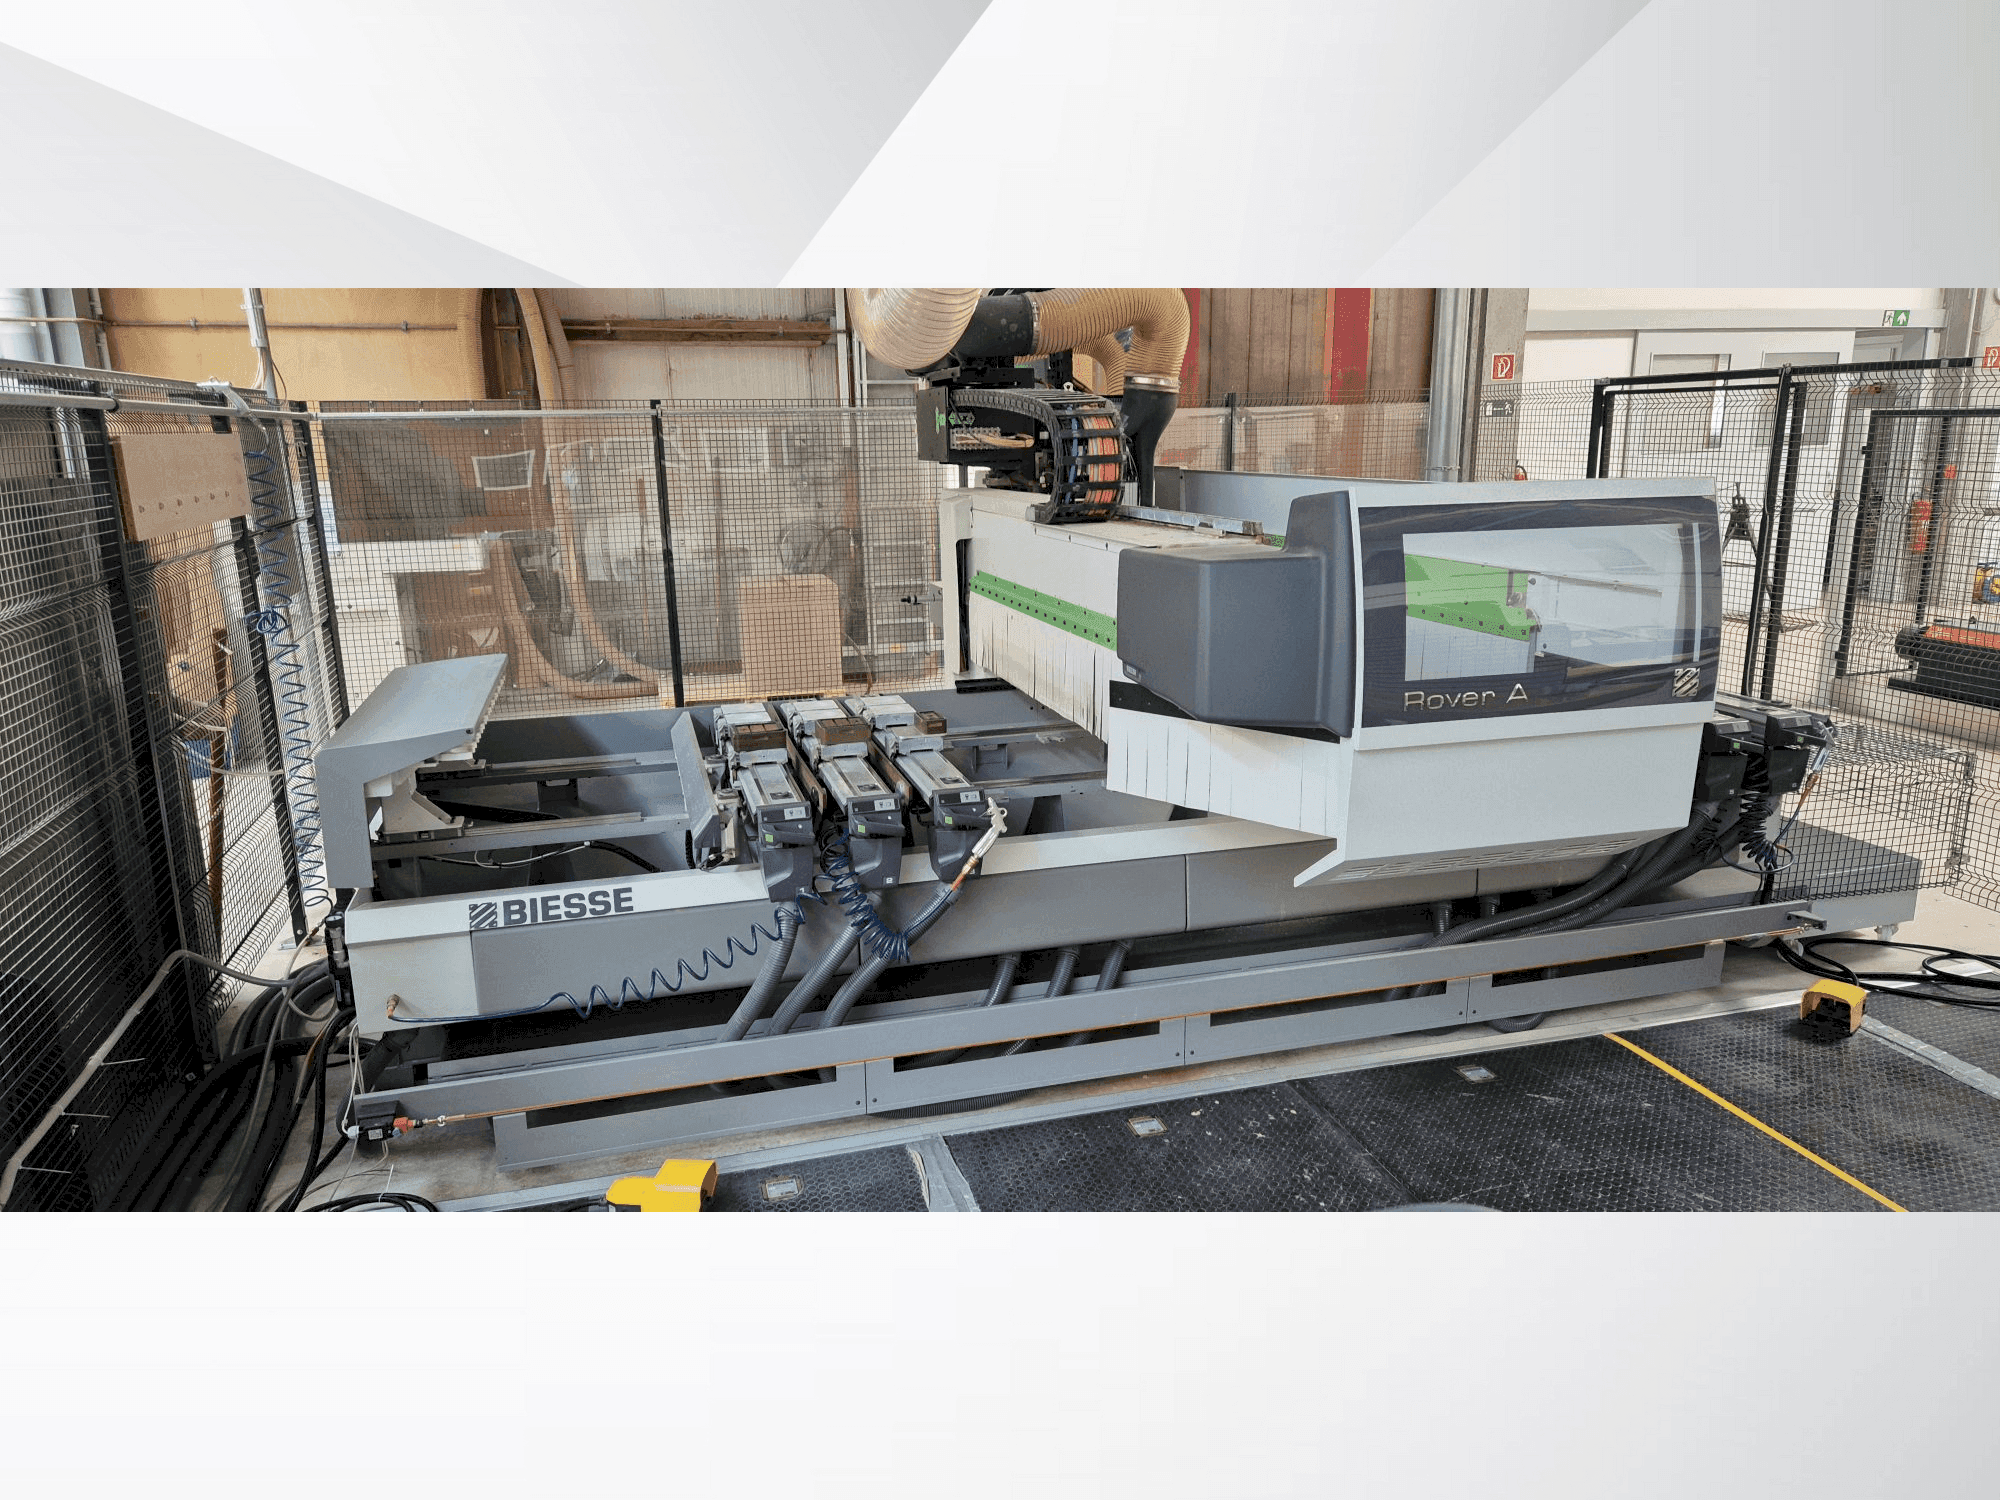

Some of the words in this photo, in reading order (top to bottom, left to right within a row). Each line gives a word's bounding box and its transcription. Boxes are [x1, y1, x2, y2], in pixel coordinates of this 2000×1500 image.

[1403, 689, 1495, 712] Rover
[1506, 683, 1529, 704] A
[502, 887, 634, 926] BIESSE
